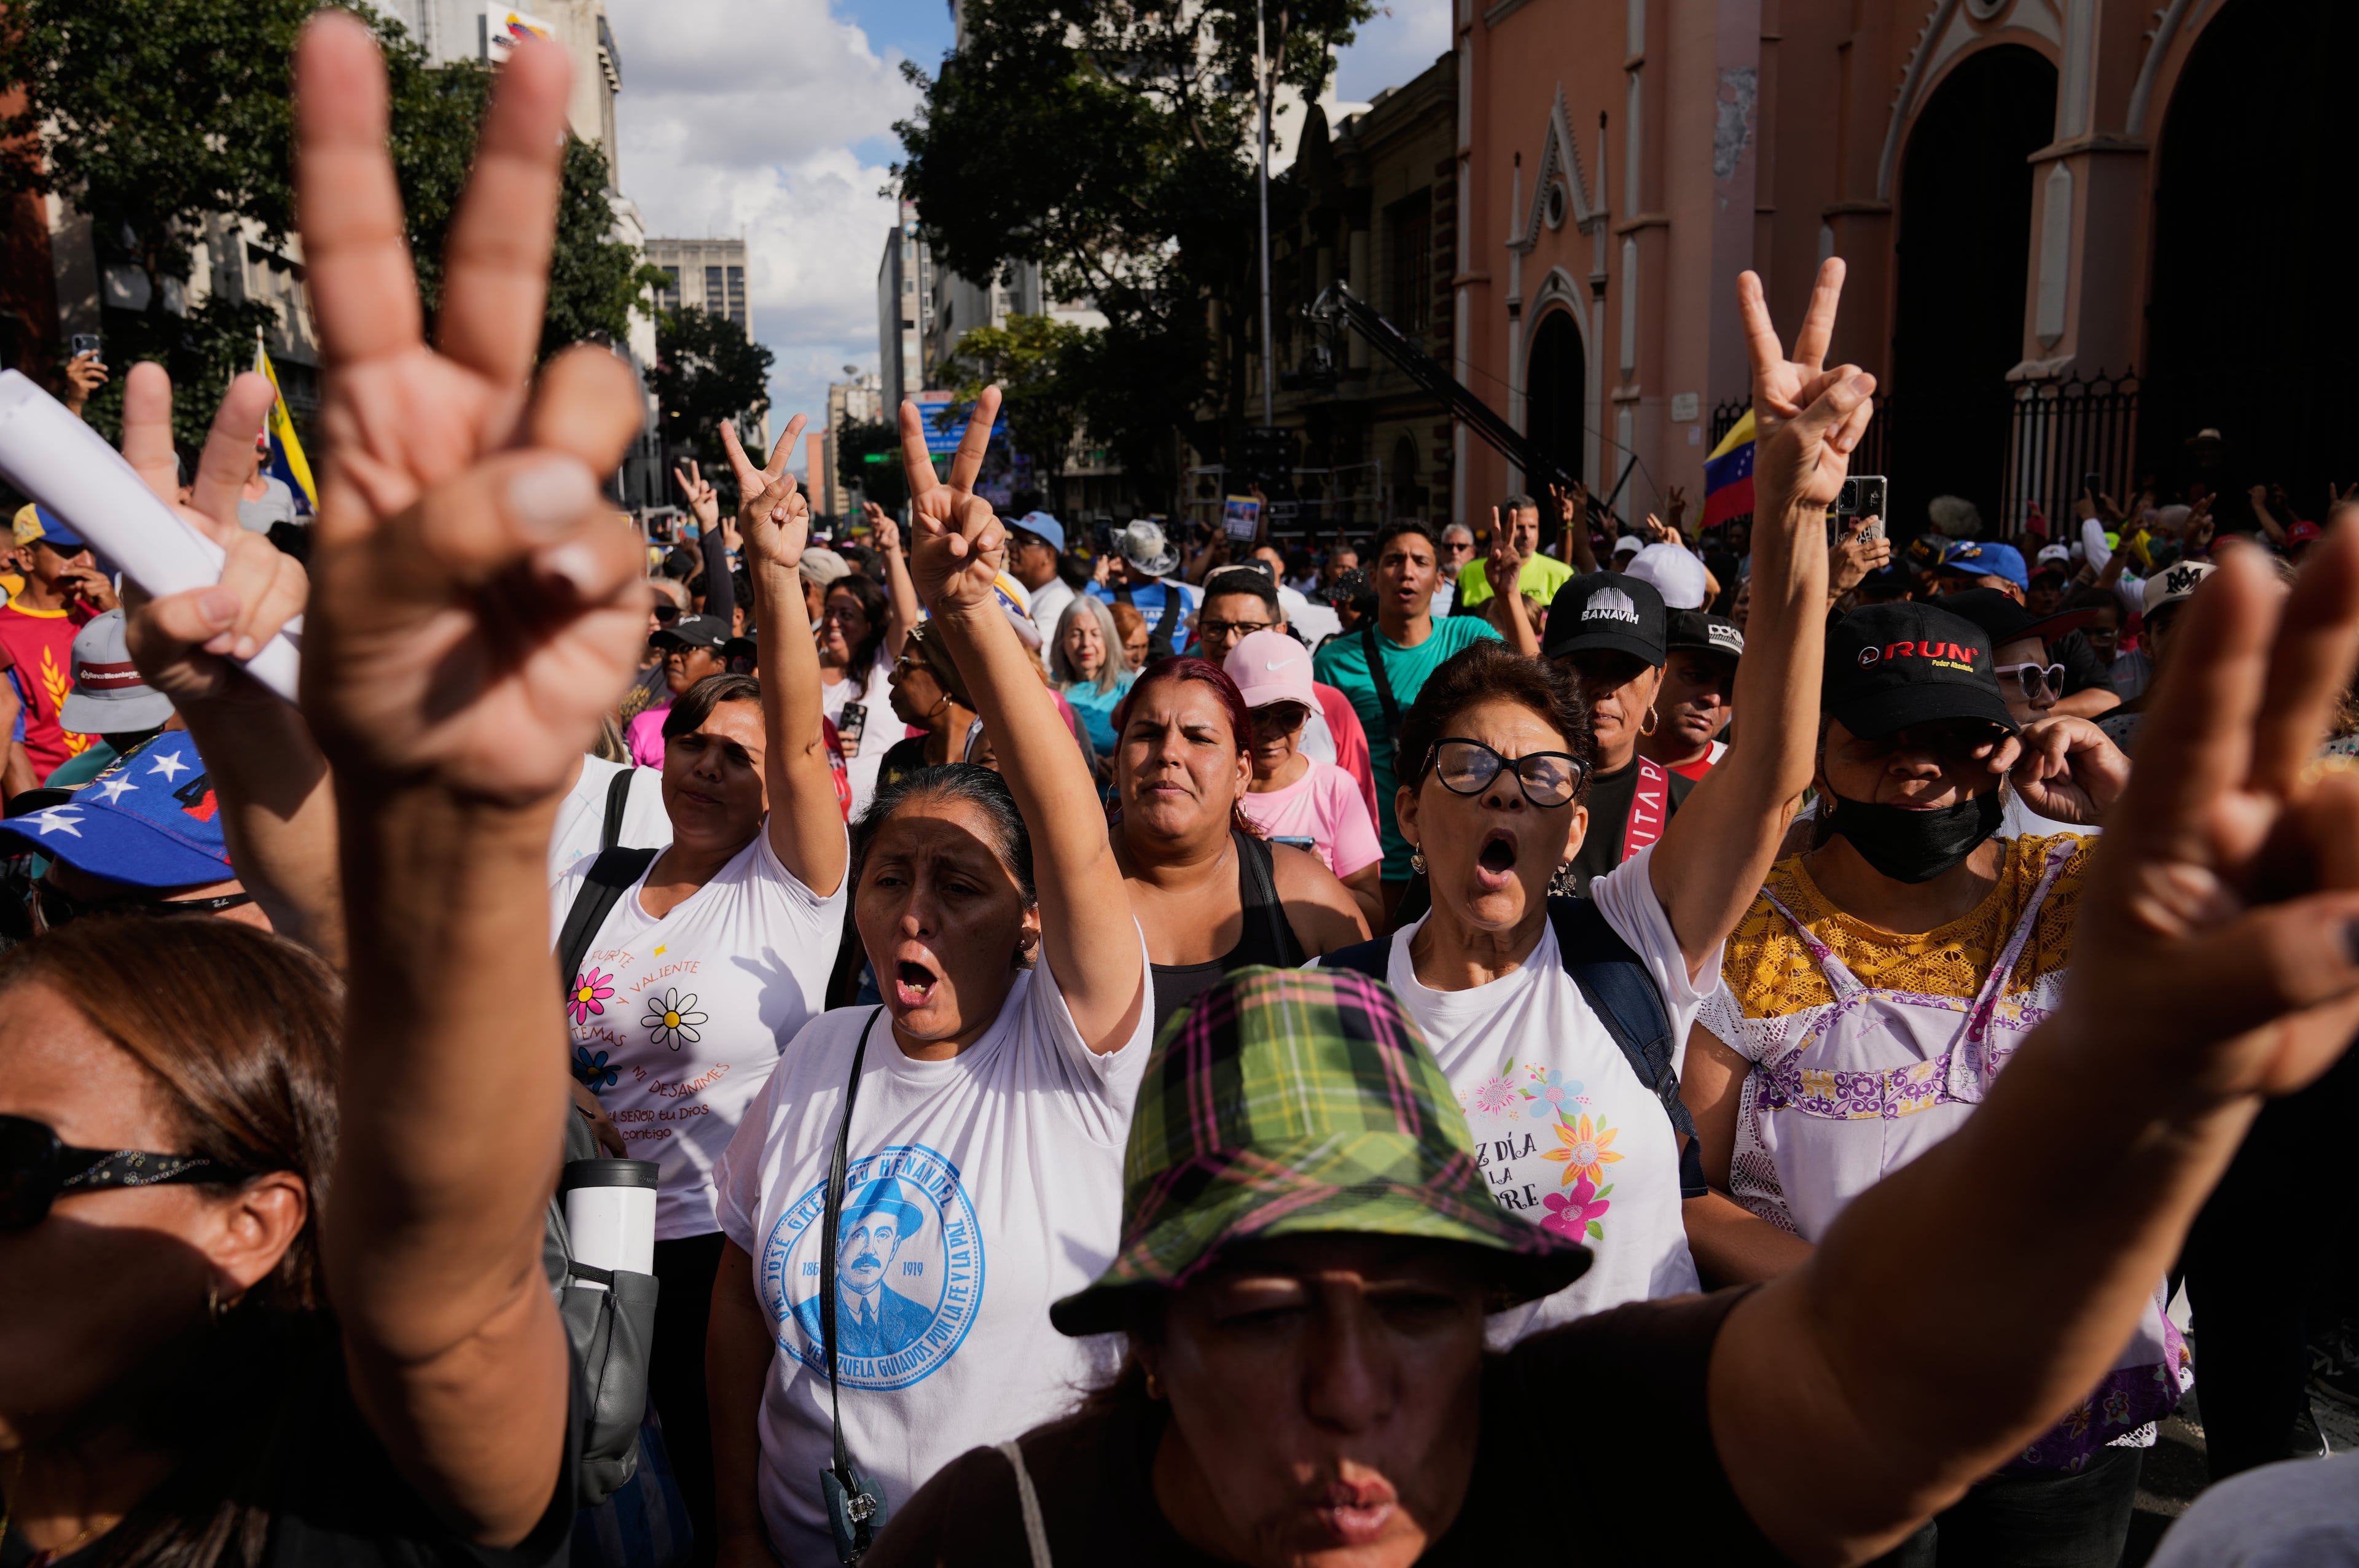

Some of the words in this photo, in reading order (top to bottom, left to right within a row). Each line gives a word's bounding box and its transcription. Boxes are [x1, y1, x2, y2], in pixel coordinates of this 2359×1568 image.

[1581, 609, 1639, 625] BANAVIH
[629, 961, 700, 992] VALIENTE
[571, 1026, 627, 1047] TEMAS
[632, 1065, 647, 1082] NI
[648, 1063, 730, 1098] DESANIMES
[620, 1110, 655, 1123] SEÑOR
[658, 1110, 676, 1120] tu
[622, 1128, 672, 1141] contigo
[1493, 1131, 1537, 1162] DÍA
[1488, 1167, 1512, 1185] LA
[945, 1218, 969, 1249] PAZ
[951, 1250, 971, 1268] LA
[802, 1262, 821, 1276] 186
[903, 1262, 923, 1276] 1919
[951, 1273, 970, 1282] Y
[947, 1285, 969, 1302] FE
[941, 1303, 964, 1321] LA
[925, 1319, 956, 1349] POR
[807, 1341, 876, 1378] VENZUELA
[877, 1341, 934, 1378] GUIADOS
